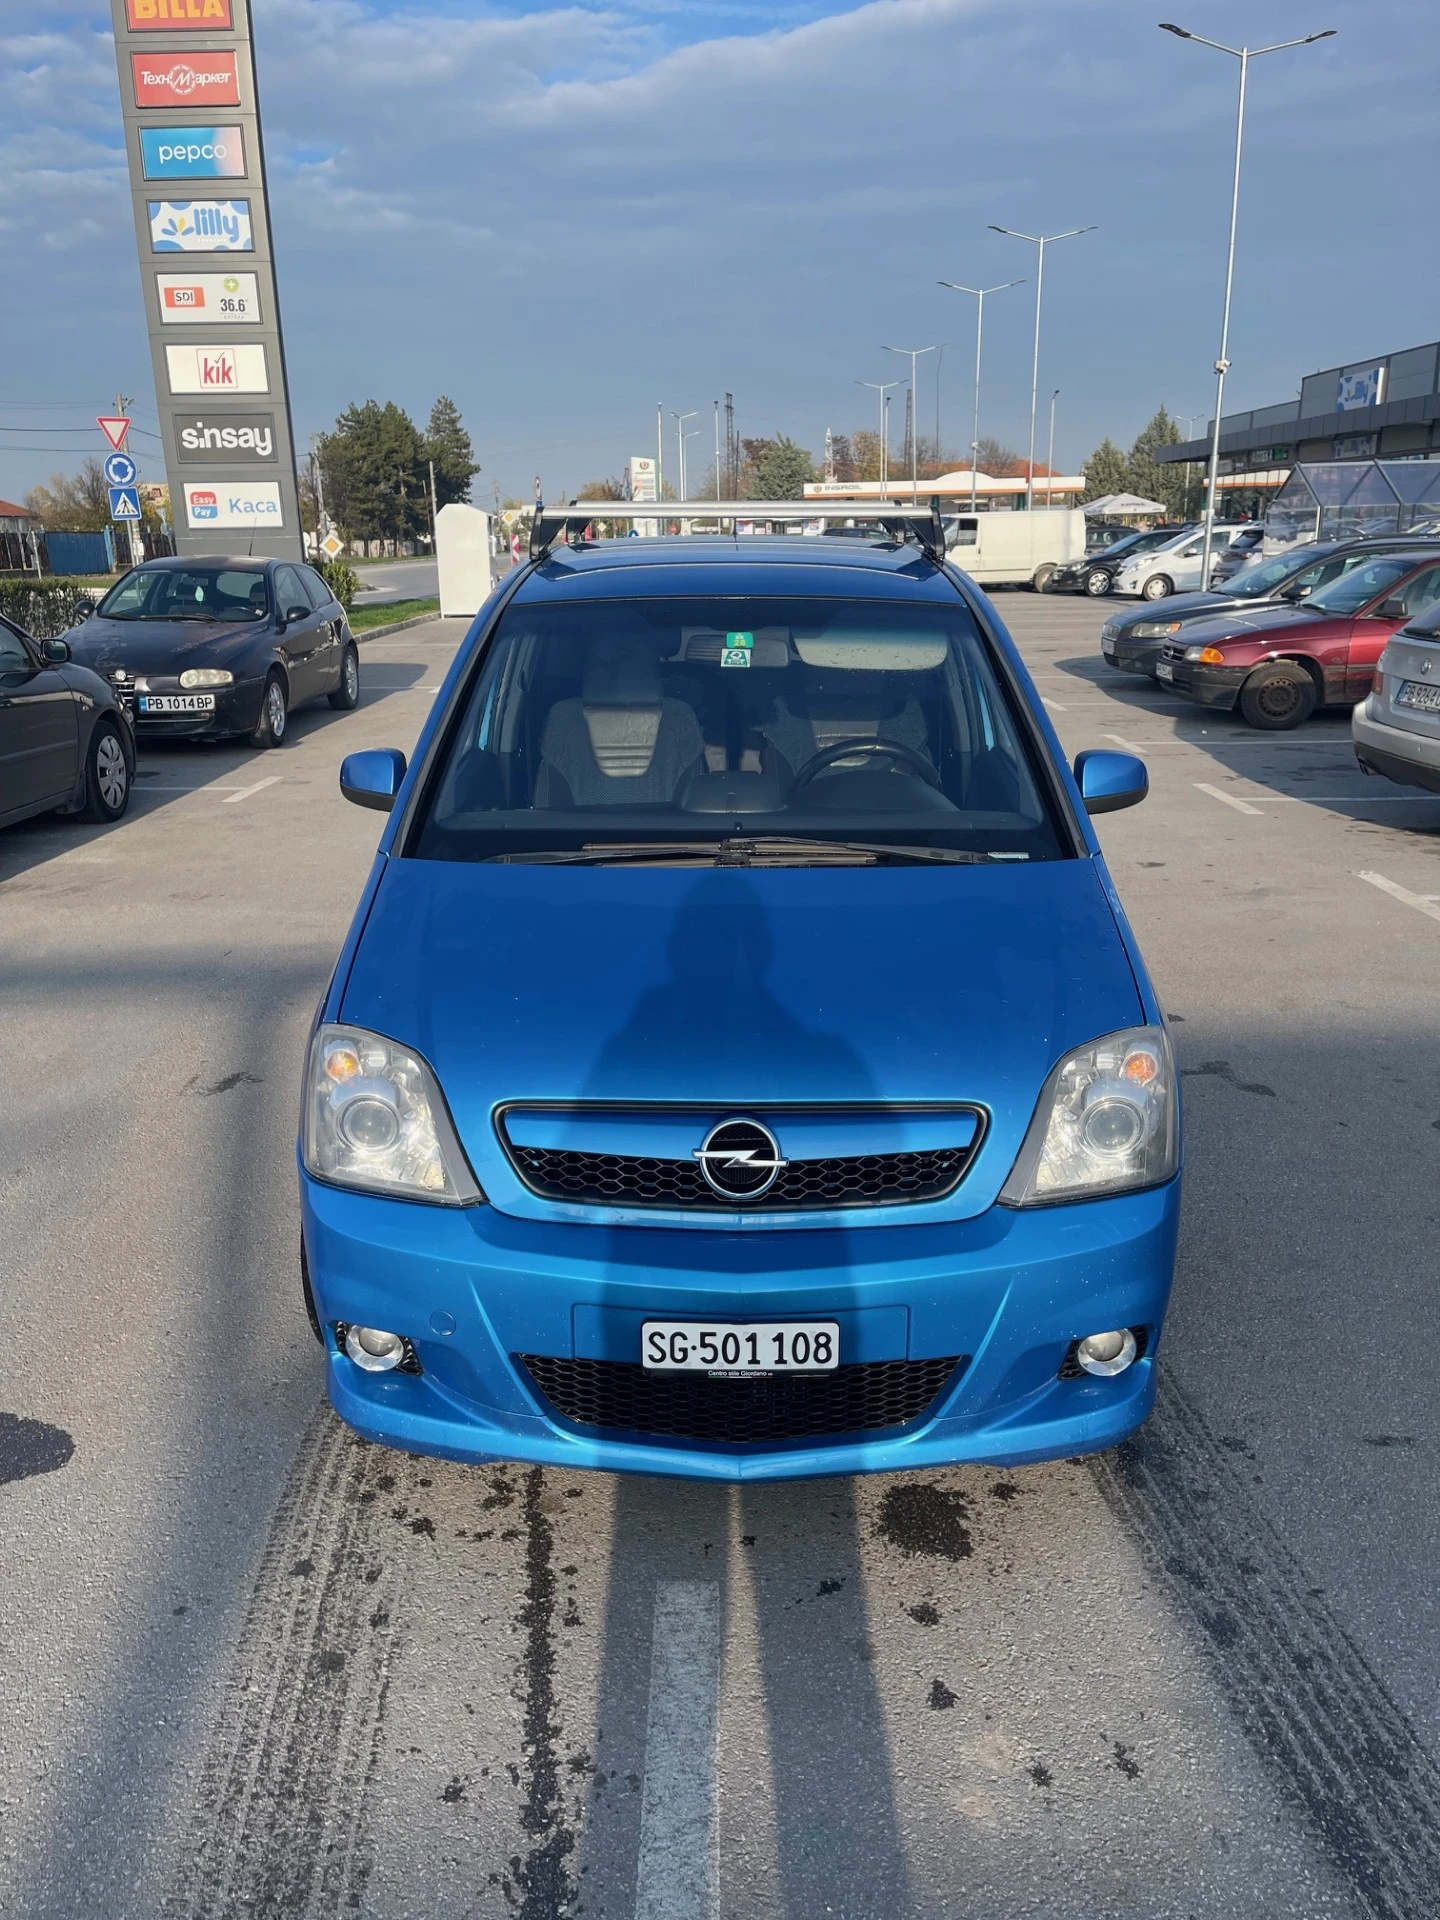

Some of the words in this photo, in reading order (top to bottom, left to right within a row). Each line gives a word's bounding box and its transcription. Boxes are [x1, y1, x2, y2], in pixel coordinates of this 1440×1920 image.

[134, 0, 225, 19] BILLA
[158, 145, 227, 164] pepco
[193, 208, 240, 243] lilly
[175, 292, 194, 302] SDI
[203, 357, 233, 384] kik
[181, 421, 273, 456] sinsay
[193, 495, 214, 506] Easy
[194, 508, 211, 517] Pay
